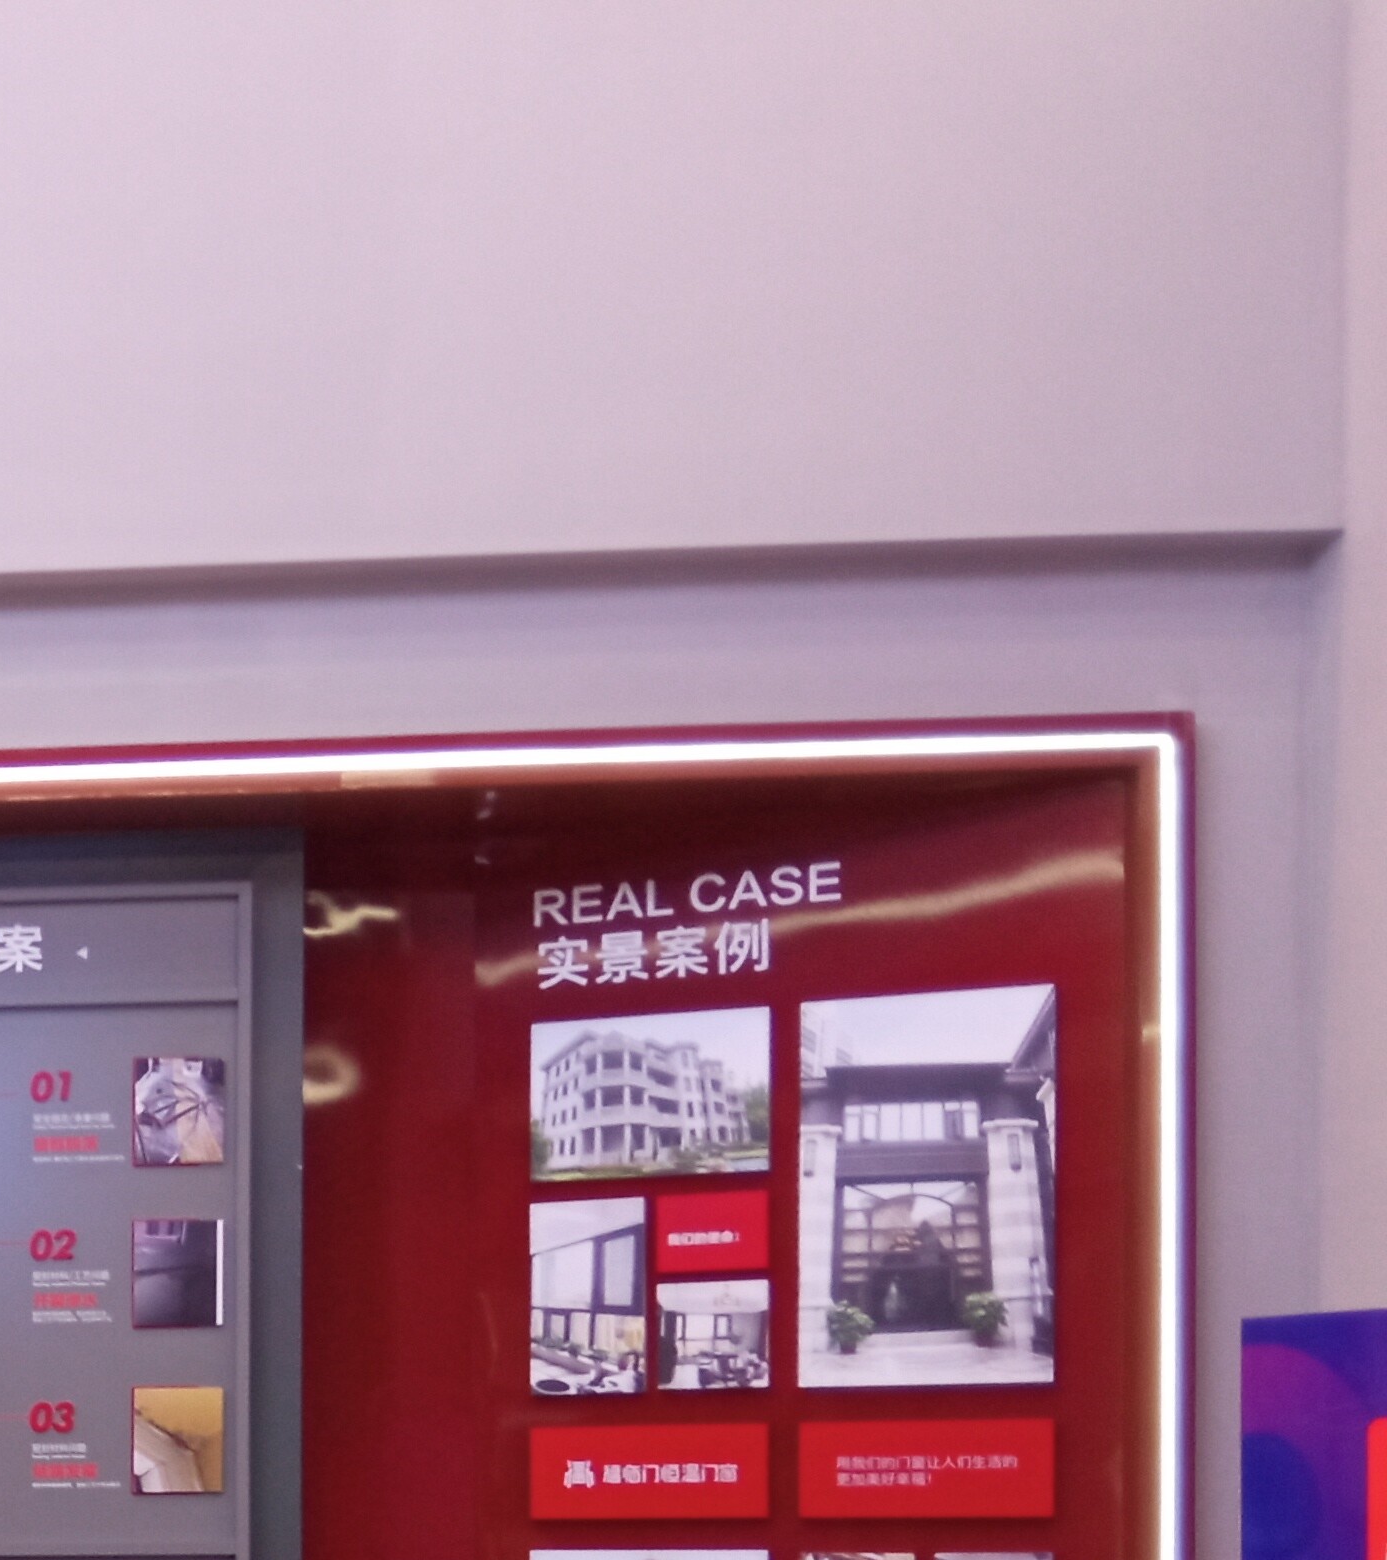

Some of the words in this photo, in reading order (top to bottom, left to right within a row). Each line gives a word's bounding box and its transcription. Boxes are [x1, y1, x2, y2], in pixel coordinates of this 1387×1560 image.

[532, 878, 674, 928] REAL
[688, 861, 843, 911] CASE
[537, 918, 771, 990] 实景案例
[30, 1070, 72, 1103] 01
[30, 1228, 77, 1261] 02
[30, 1400, 75, 1433] 03
